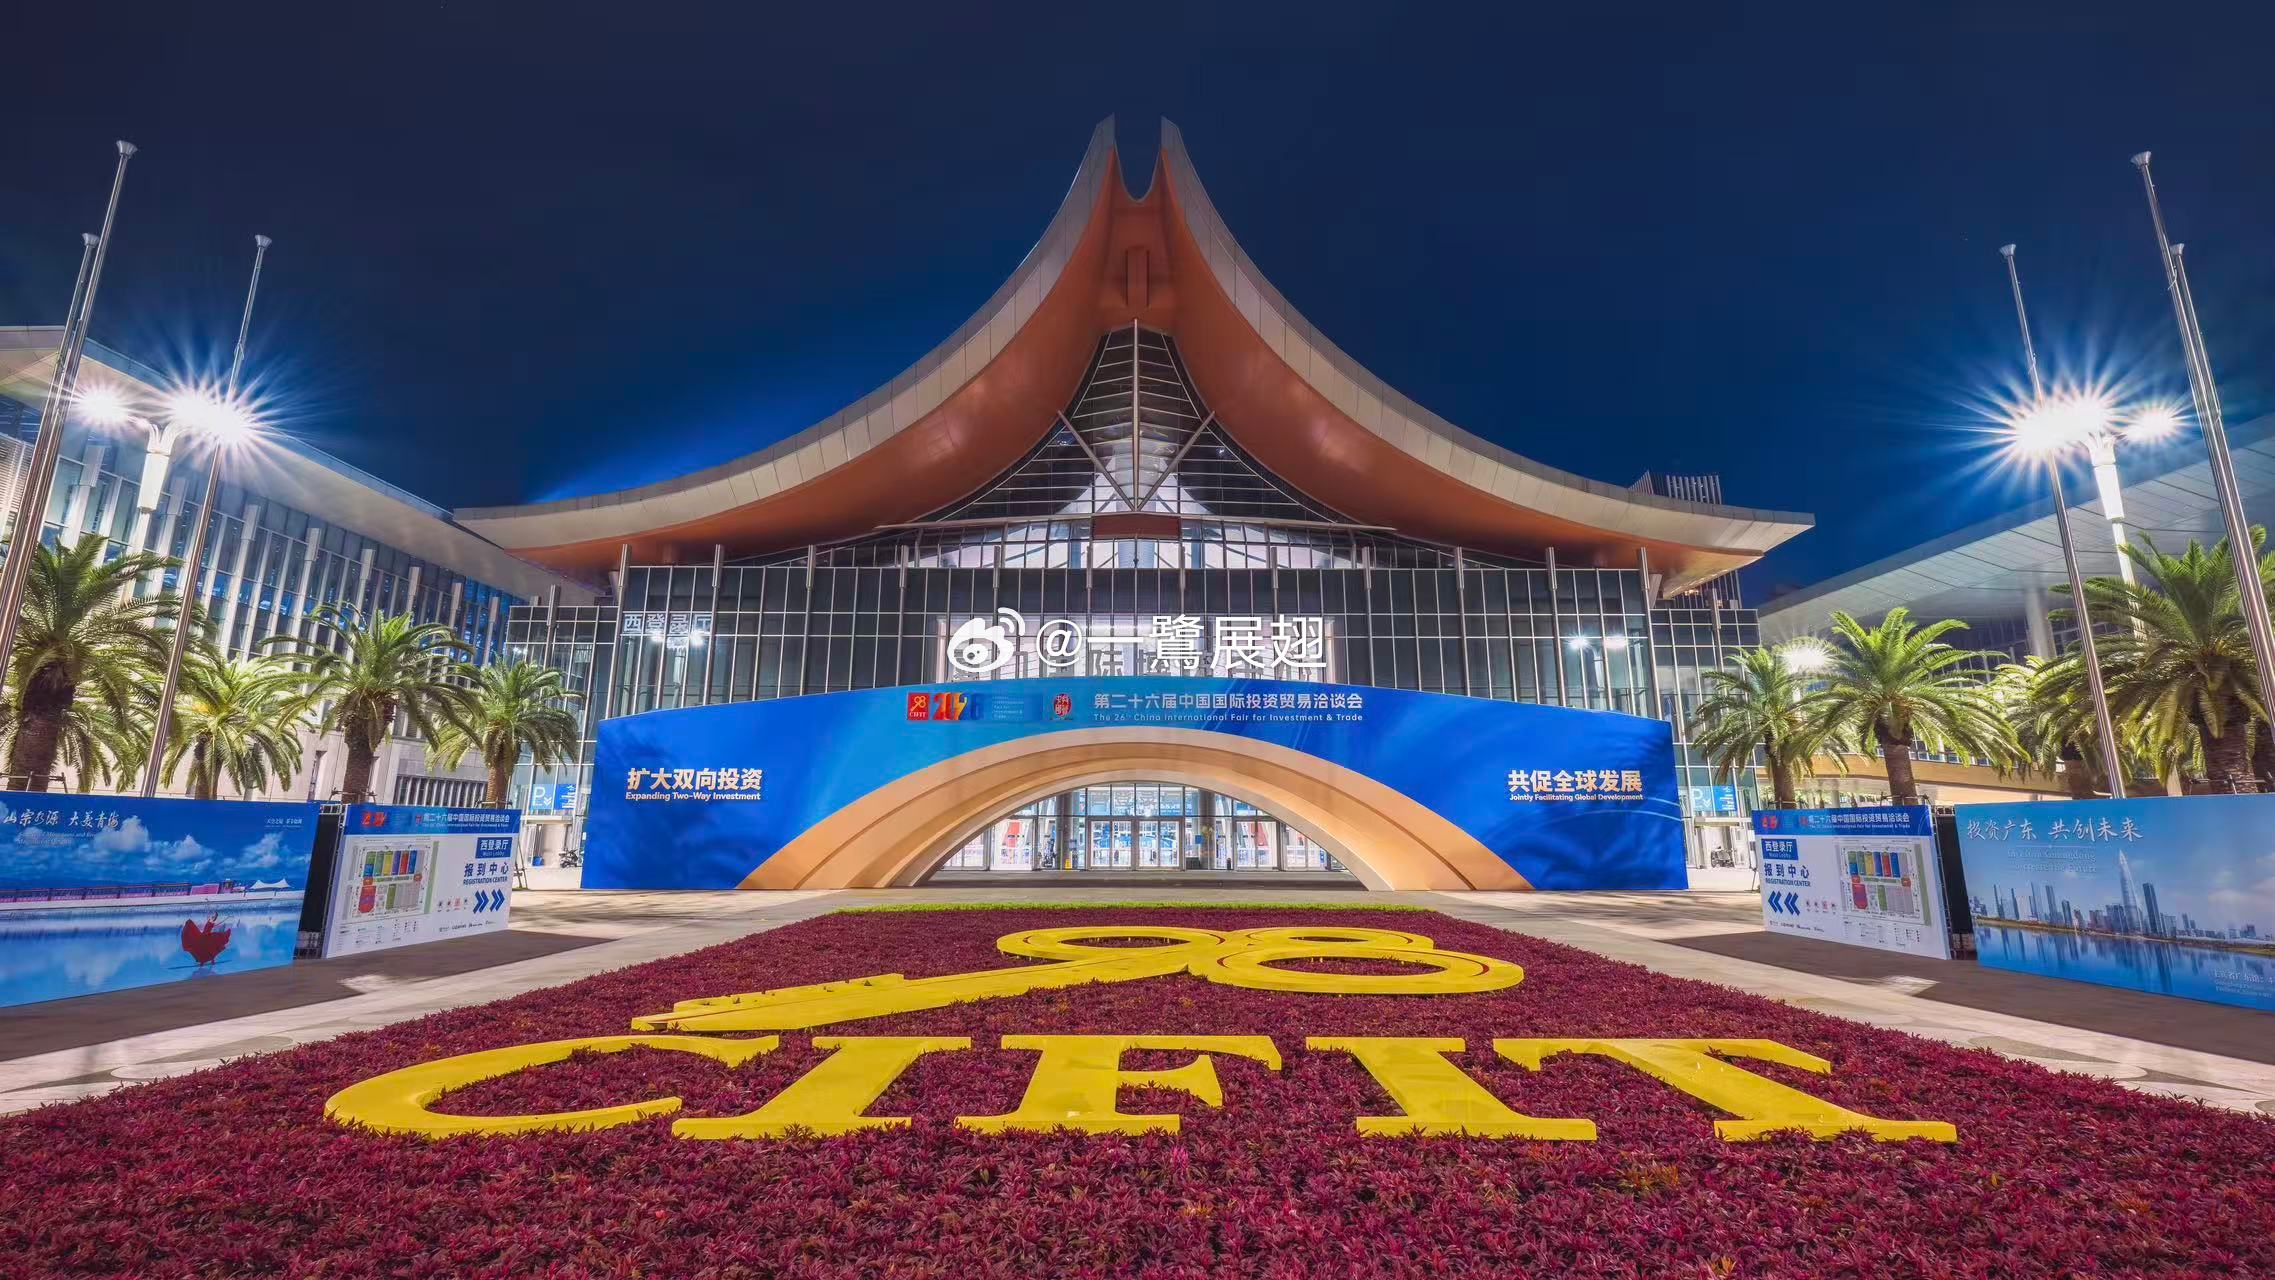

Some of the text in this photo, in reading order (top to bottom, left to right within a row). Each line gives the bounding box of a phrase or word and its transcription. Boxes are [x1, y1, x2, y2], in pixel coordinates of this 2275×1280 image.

[1094, 693, 1363, 710] 第二十六届中国国际投资贸易洽谈会
[1094, 713, 1111, 721] The
[1134, 713, 1161, 721] China
[1164, 713, 1227, 721] International
[1230, 713, 1249, 721] Fair
[1252, 713, 1266, 721] for
[1269, 713, 1323, 721] Investment
[1326, 713, 1333, 721] &
[1337, 713, 1363, 721] Trade
[627, 767, 763, 791] 扩大双向投资
[1507, 769, 1643, 793] 共促全球发展
[625, 791, 761, 802] Expanding Two-Way Investment
[1509, 793, 1644, 803] Jointly Facilitating Global Development
[68, 810, 121, 829] 大美青海
[1966, 816, 2144, 843] 投资广东 共创未来
[1764, 840, 1793, 853] 西登录厅
[463, 861, 509, 878] 报到中心
[1763, 862, 1810, 879] 报到中心
[463, 877, 492, 885] REGISTRATION
[323, 1034, 1960, 1143] CIFIT
